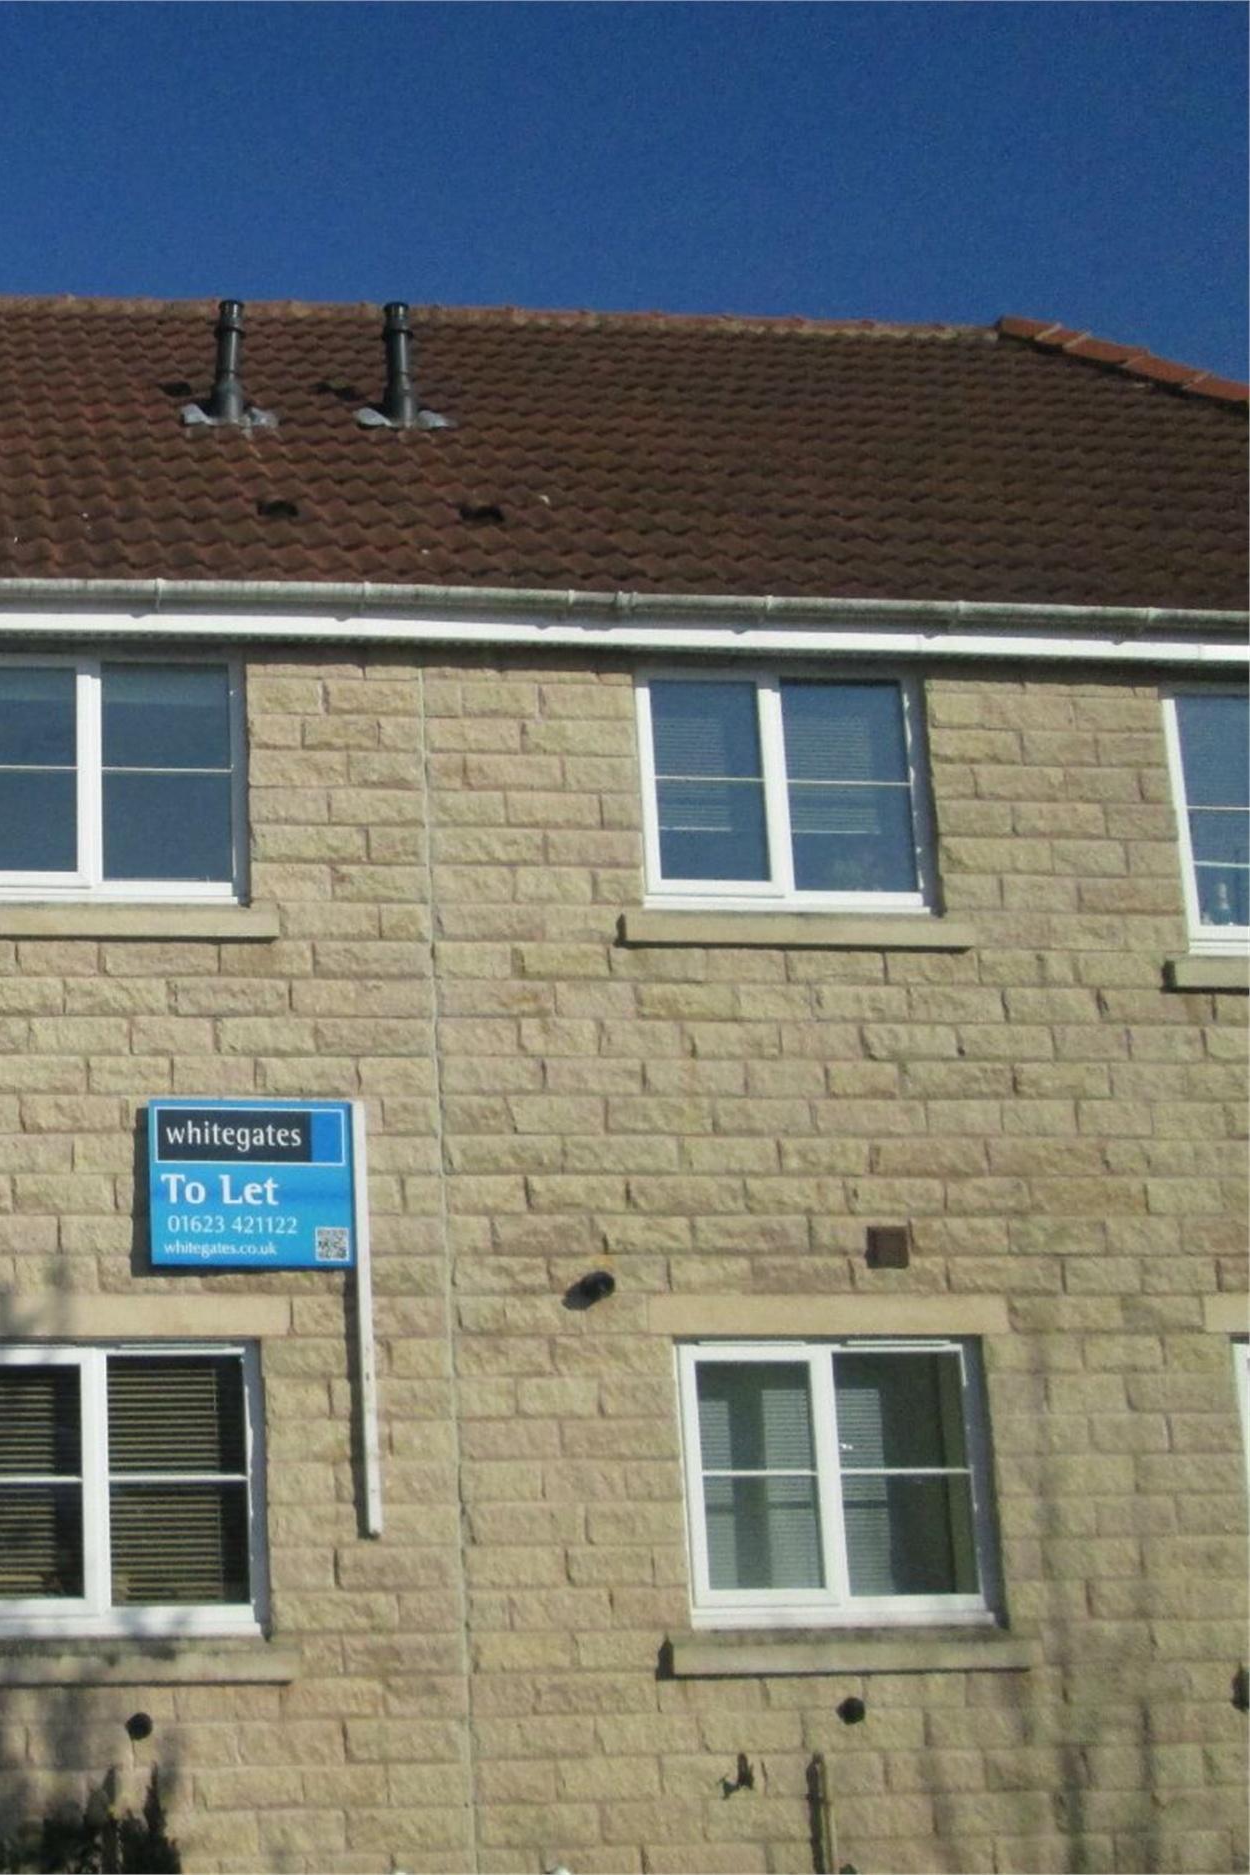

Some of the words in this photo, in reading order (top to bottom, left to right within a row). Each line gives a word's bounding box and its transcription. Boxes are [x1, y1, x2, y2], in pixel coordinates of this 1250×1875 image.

[165, 1120, 302, 1153] whitegates
[160, 1172, 206, 1204] To
[218, 1174, 279, 1206] Let
[167, 1215, 225, 1234] 01623
[231, 1216, 298, 1235] 421122
[164, 1240, 277, 1258] whitegates.co.uk
